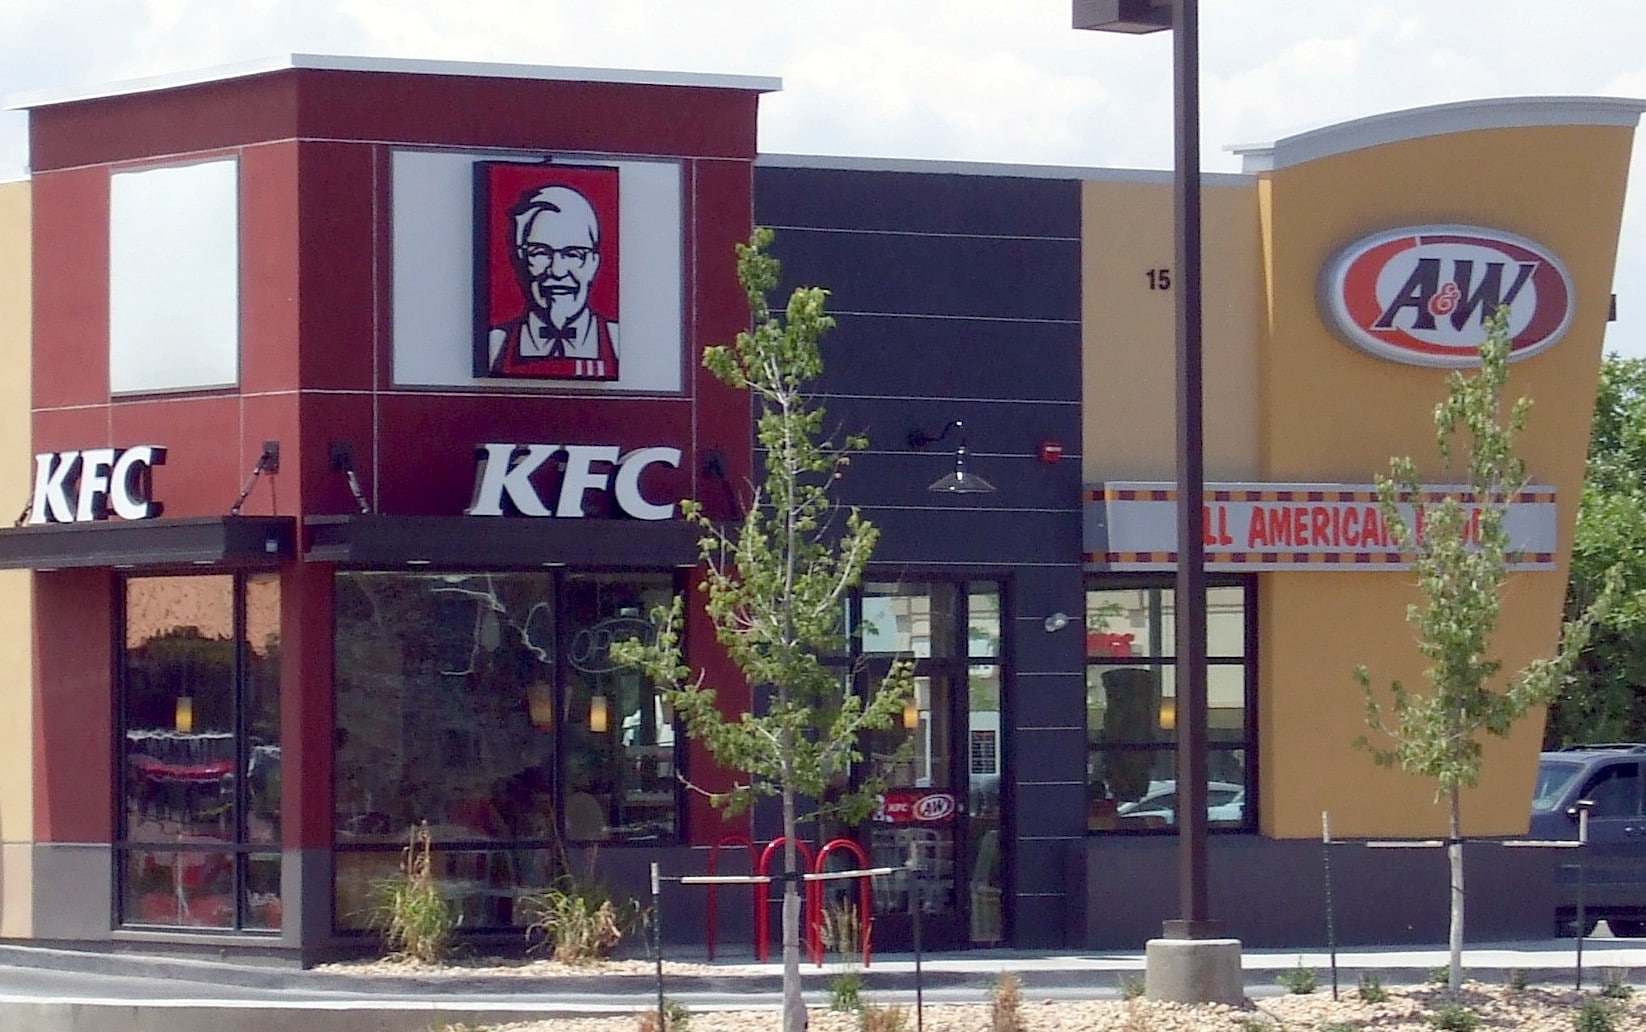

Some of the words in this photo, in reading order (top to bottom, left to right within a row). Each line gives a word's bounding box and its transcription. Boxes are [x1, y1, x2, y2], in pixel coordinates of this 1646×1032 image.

[1146, 269, 1171, 290] 15
[1370, 257, 1540, 332] A&W
[29, 445, 154, 525] KFC
[468, 443, 682, 521] KFC
[1202, 505, 1233, 546] LL
